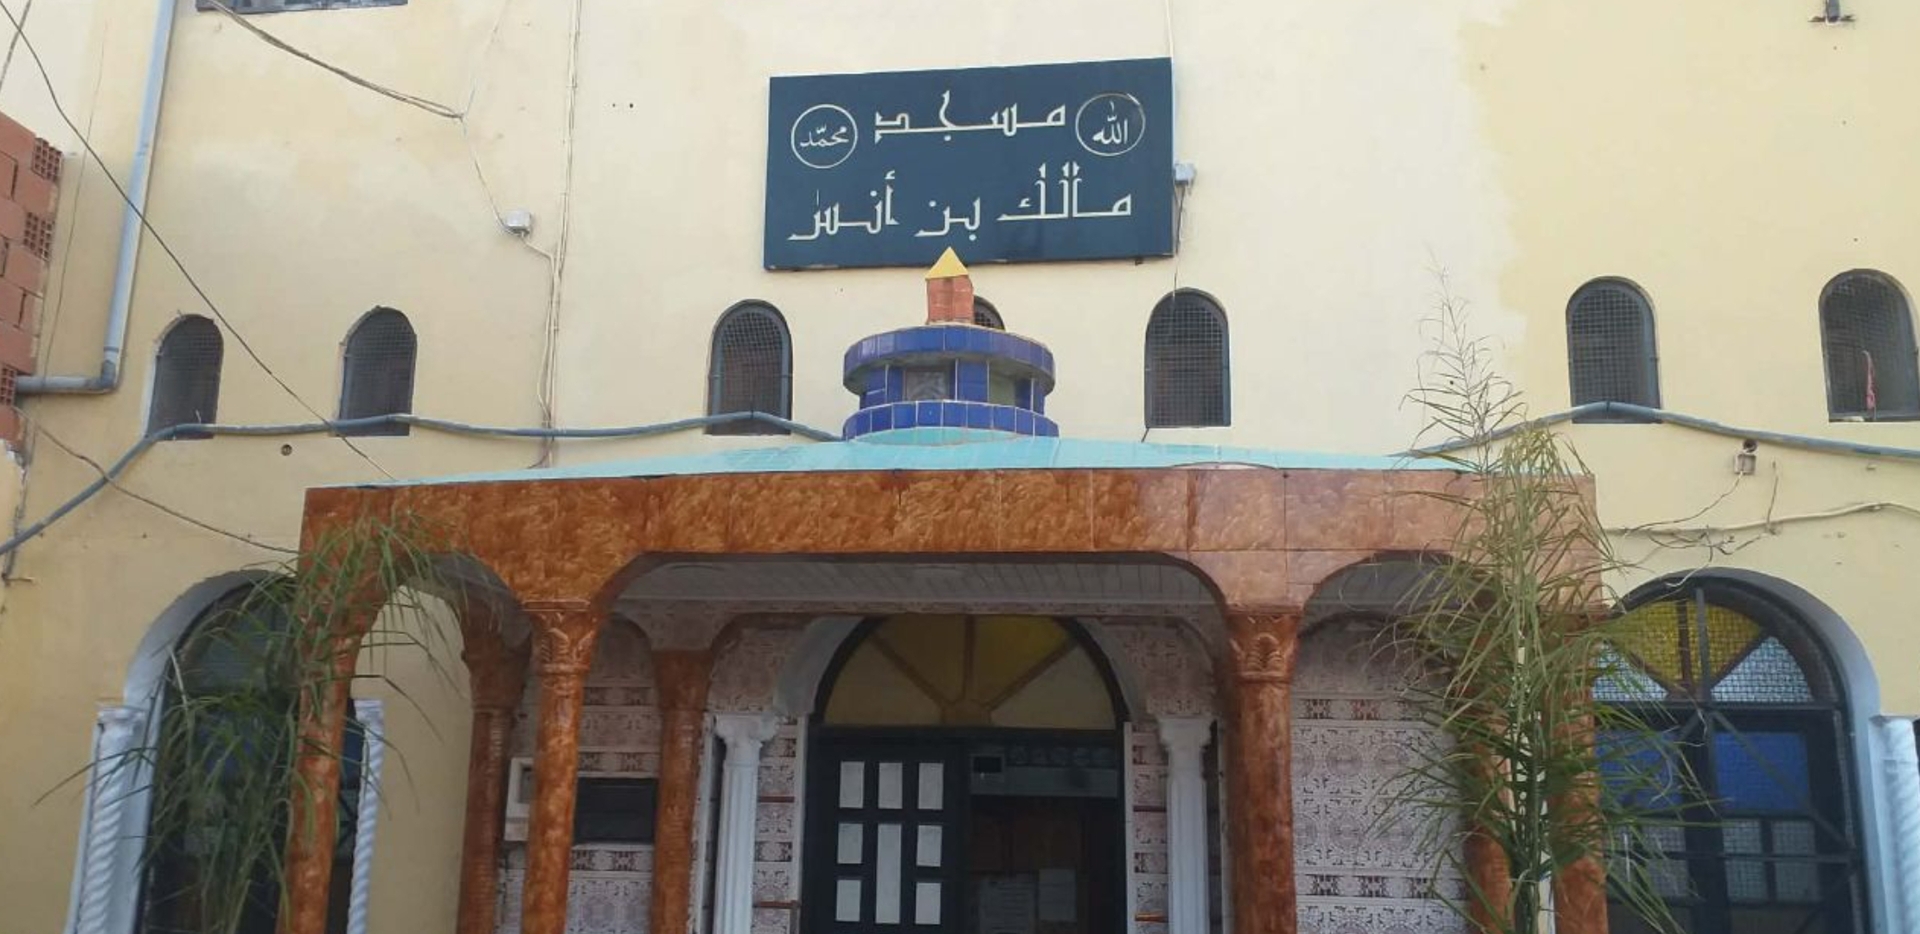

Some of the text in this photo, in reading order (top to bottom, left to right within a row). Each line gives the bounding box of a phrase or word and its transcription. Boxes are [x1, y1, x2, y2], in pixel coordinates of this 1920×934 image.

[874, 89, 1066, 144] مسجد
[786, 161, 1133, 242] مالك بن أنس
